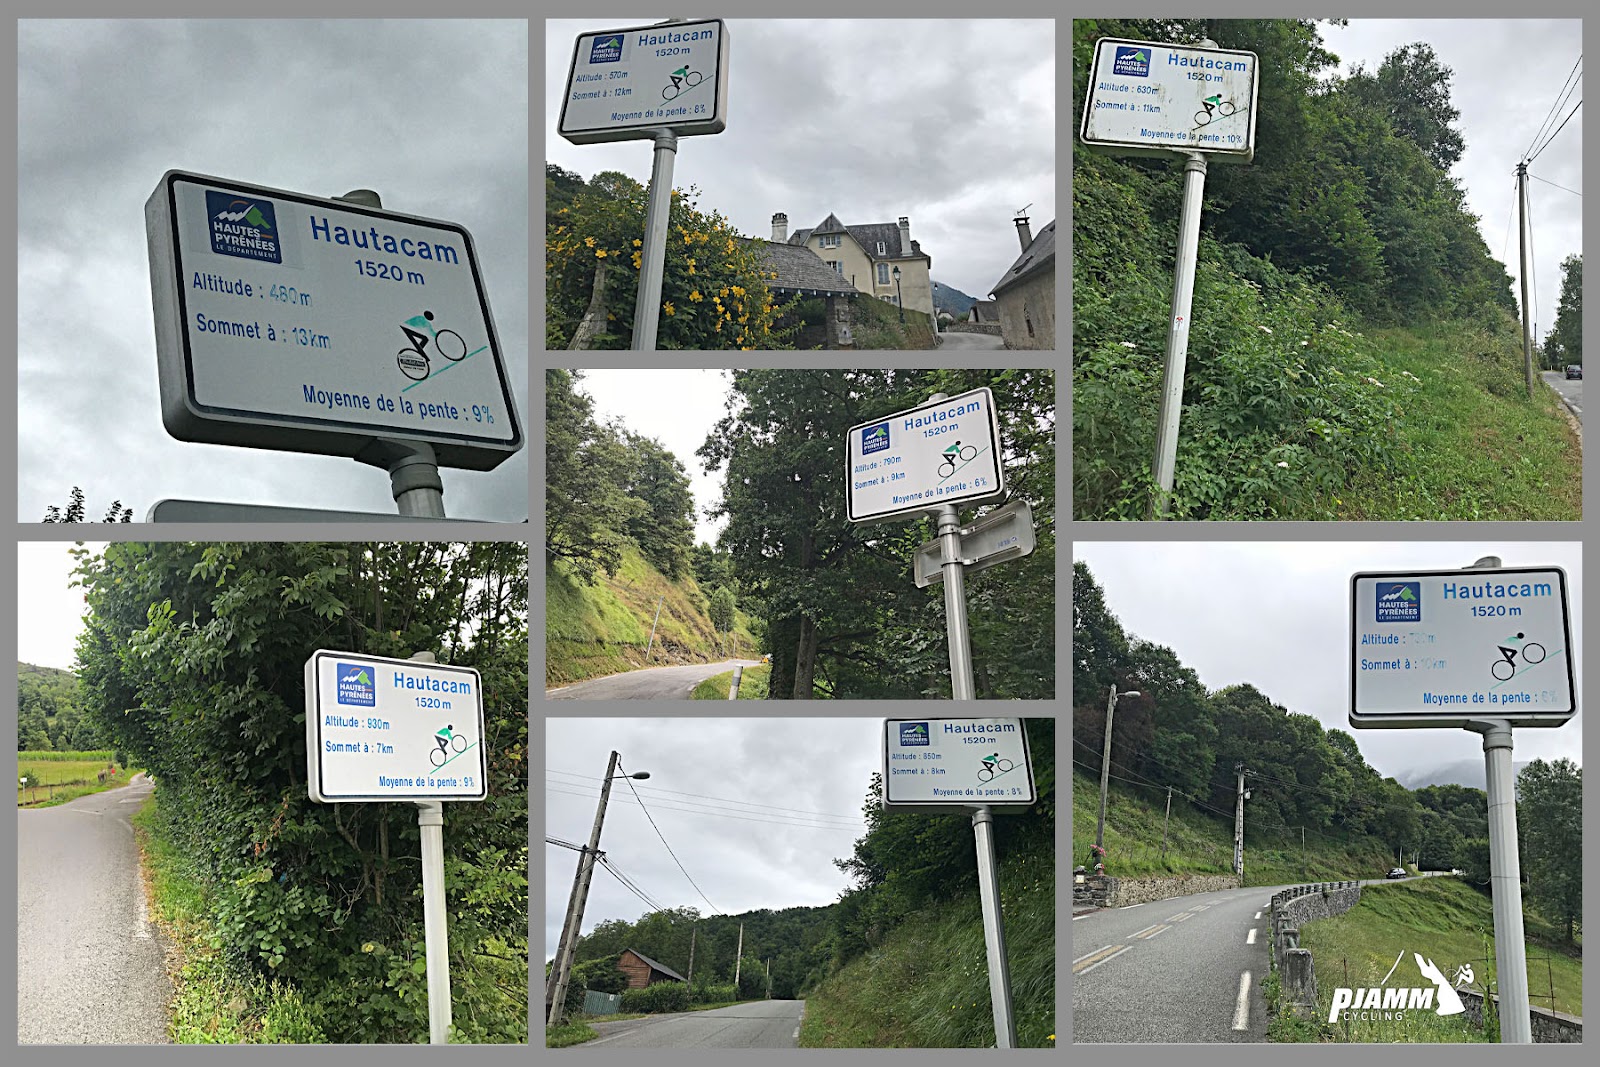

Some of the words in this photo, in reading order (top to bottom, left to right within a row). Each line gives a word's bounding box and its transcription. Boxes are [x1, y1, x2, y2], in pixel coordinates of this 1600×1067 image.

[639, 30, 712, 46] Hautacam
[656, 48, 680, 56] 1520
[1169, 54, 1246, 72] Hautacam
[576, 73, 602, 82] Altitude
[1187, 72, 1212, 81] 1520
[573, 91, 599, 100] Sommet
[615, 88, 631, 96] 12km
[1099, 82, 1128, 92] Altitude
[1137, 85, 1158, 95] 630m
[611, 111, 642, 121] Moyenne
[645, 108, 653, 118] de
[657, 108, 664, 116] la
[666, 108, 686, 117] pente
[695, 105, 705, 113] 8%
[1096, 100, 1127, 110] Sommet
[1143, 104, 1160, 113] 11km
[1141, 128, 1174, 139] Moyenne
[1177, 130, 1186, 139] de
[1189, 132, 1195, 141] la
[1228, 135, 1242, 143] 10%
[214, 222, 260, 237] HAUTES
[215, 233, 275, 251] PYRÉNÉES
[310, 216, 459, 264] Hautacam
[355, 260, 403, 282] 1520
[193, 272, 253, 297] Altitude
[197, 313, 261, 339] Sommet
[292, 327, 331, 349] 13km
[303, 385, 370, 410] Moyenne
[377, 395, 395, 412] de
[399, 397, 413, 415] la
[419, 403, 458, 423] pente
[472, 405, 494, 424] 9%
[905, 401, 980, 431] Hautacam
[924, 426, 948, 438] 1520
[855, 462, 877, 473] Altitude
[884, 456, 901, 465] 790m
[855, 478, 879, 490] Sommet
[891, 472, 905, 480] 9km
[892, 492, 922, 504] Moyenne
[925, 488, 933, 497] de
[936, 486, 943, 495] la
[946, 482, 966, 494] pente
[1444, 582, 1551, 599] Hautacam
[1471, 606, 1506, 617] 1520
[1362, 634, 1398, 644] Altitude
[1362, 659, 1400, 670] Sommet
[395, 672, 470, 694] Hautacam
[340, 691, 373, 699] PYRÉNÉES
[1424, 693, 1467, 705] Moyenne
[1472, 692, 1484, 702] de
[1489, 692, 1498, 702] la
[1502, 692, 1530, 705] pente
[415, 698, 440, 708] 1520
[325, 716, 358, 727] Altitude
[368, 719, 390, 729] 930m
[944, 724, 1015, 733] Hautacam
[326, 741, 360, 752] Sommet
[377, 743, 393, 753] 7km
[379, 776, 412, 788] Moyenne
[416, 777, 425, 786] de
[428, 777, 434, 786] la
[437, 778, 457, 788] pente
[464, 777, 474, 787] 9%
[934, 788, 962, 796] Moyenne
